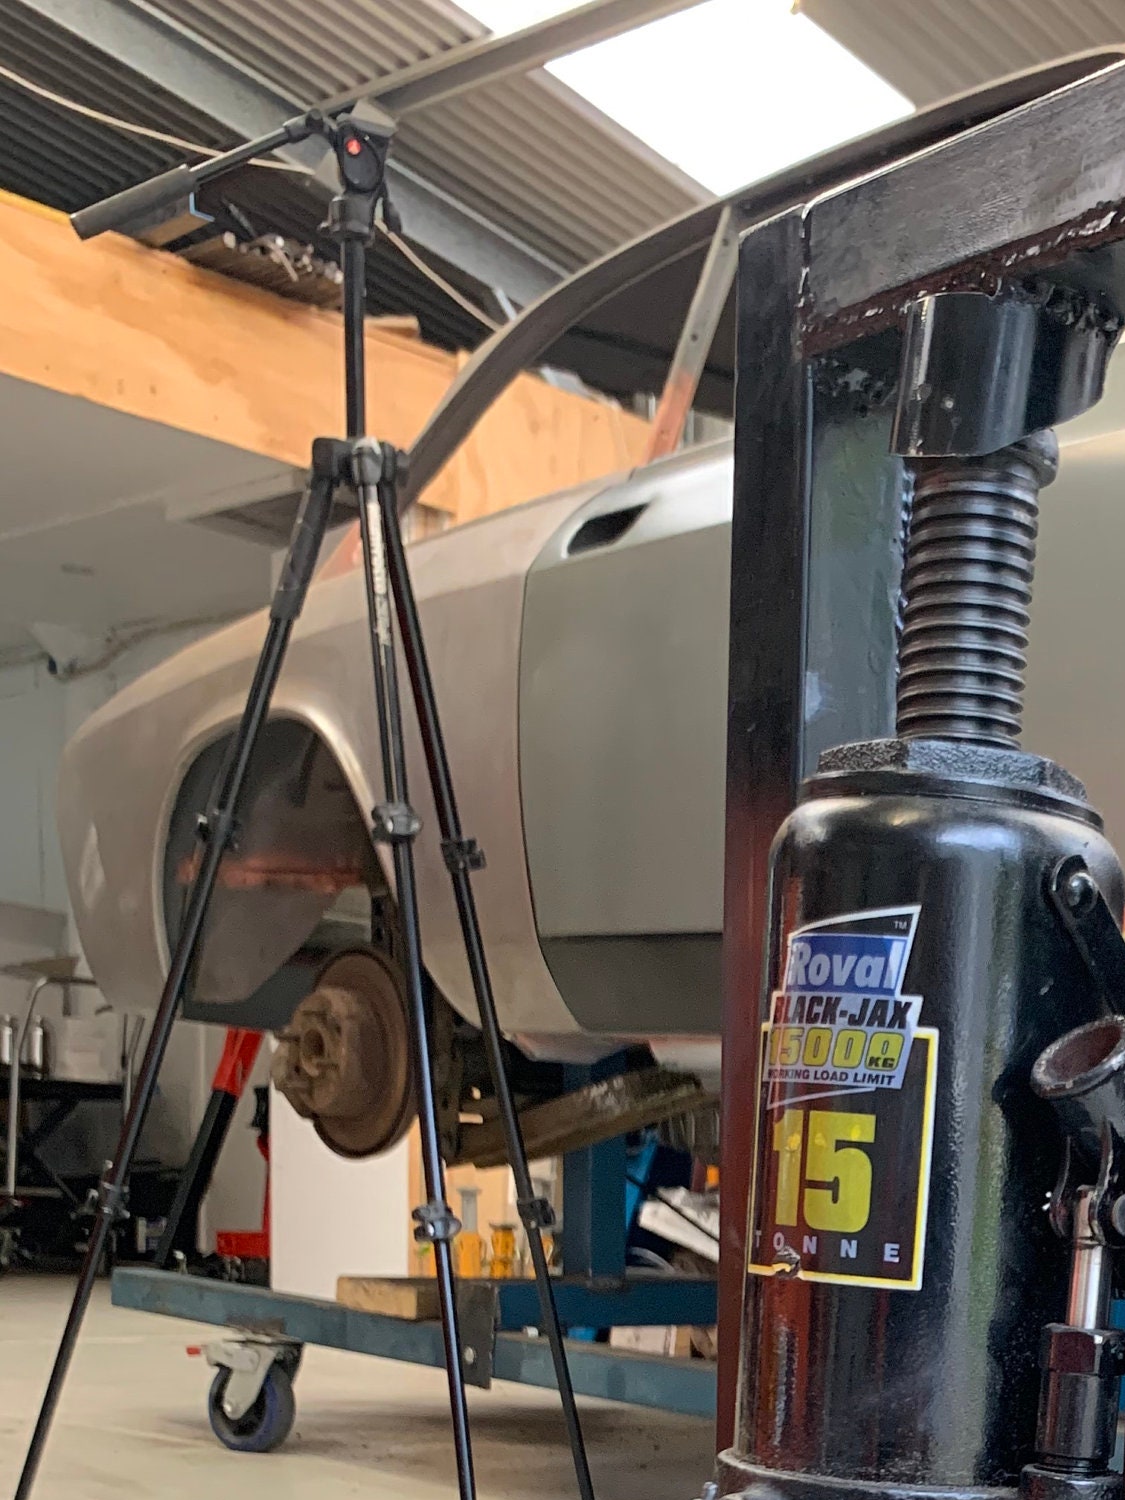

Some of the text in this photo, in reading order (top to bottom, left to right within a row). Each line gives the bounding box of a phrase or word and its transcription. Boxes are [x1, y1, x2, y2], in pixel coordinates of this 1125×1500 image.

[788, 941, 905, 990] Roval
[813, 1070, 849, 1082] LOAD
[852, 1072, 896, 1086] LIMIT
[868, 1057, 895, 1068] KG
[773, 1109, 876, 1233] 15
[755, 1229, 900, 1264] TONNE
